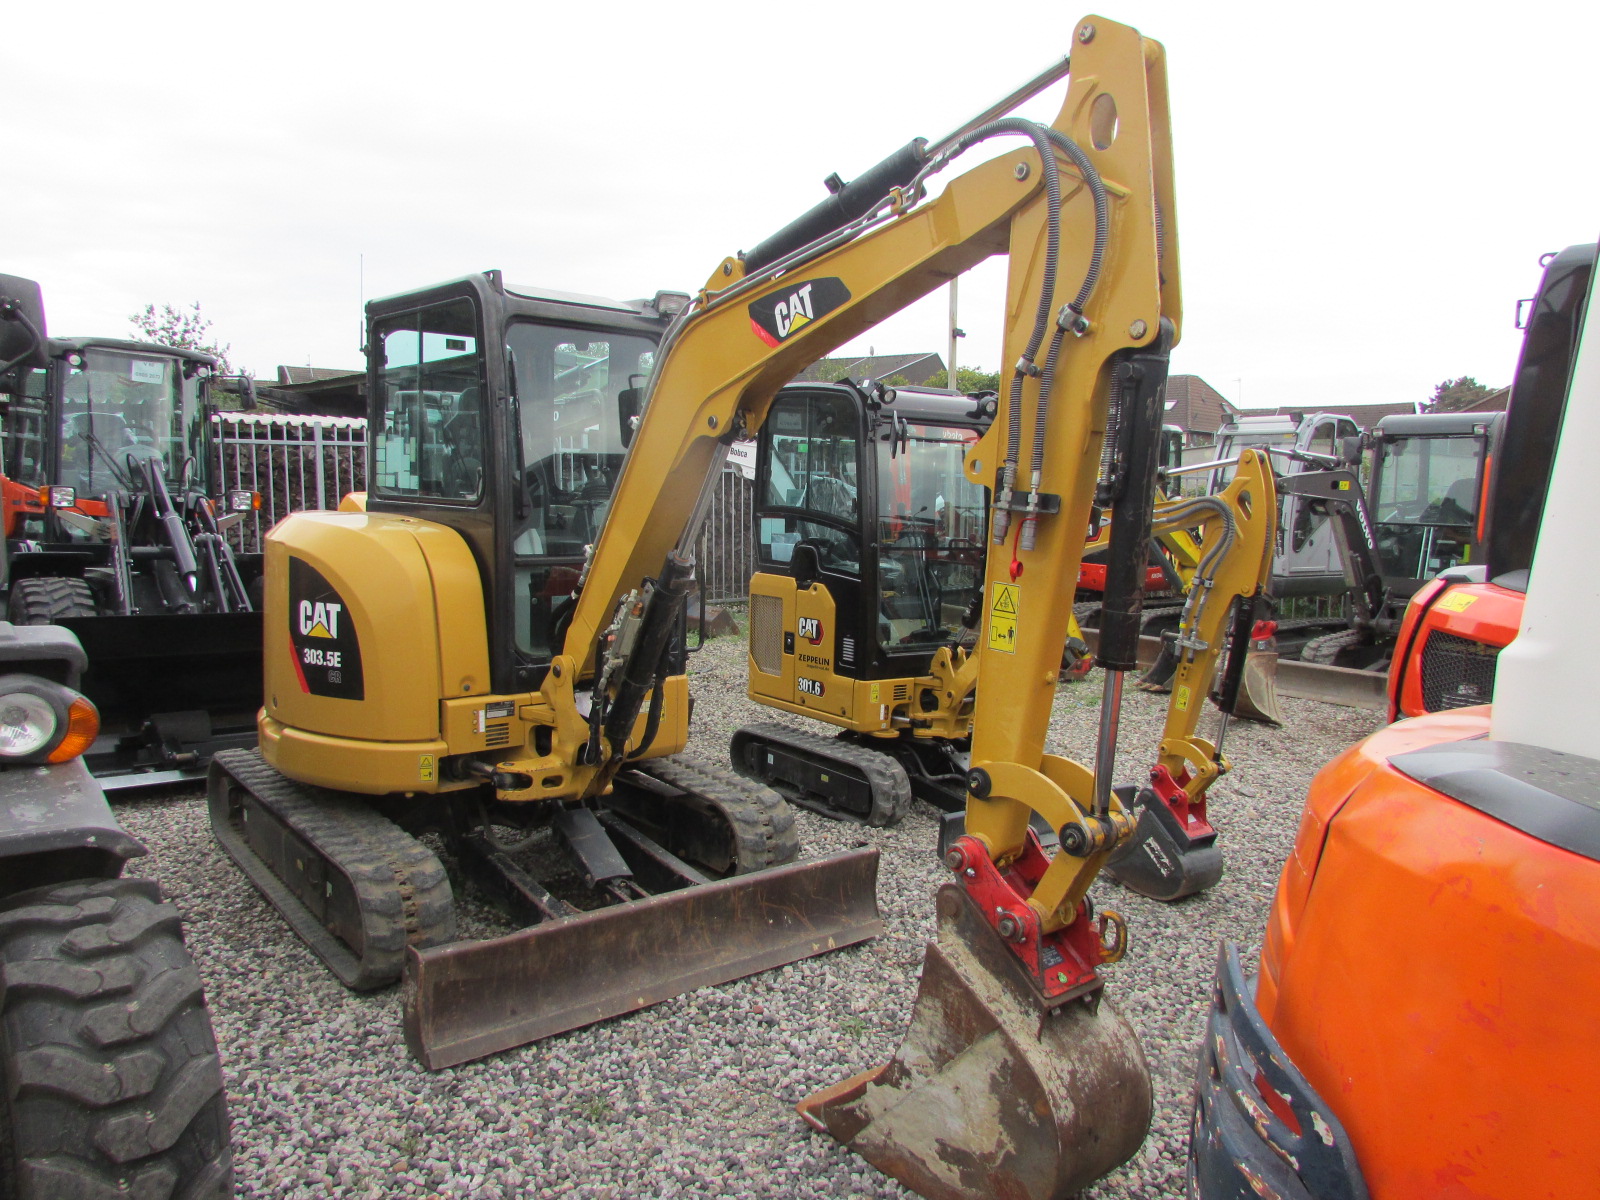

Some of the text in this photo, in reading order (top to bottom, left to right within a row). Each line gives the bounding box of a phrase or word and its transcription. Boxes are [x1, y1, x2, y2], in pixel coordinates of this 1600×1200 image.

[774, 283, 814, 338] CAT
[1356, 498, 1373, 550] VOLVO
[299, 600, 342, 639] CAT
[798, 617, 818, 639] CAT
[303, 647, 342, 668] 303.5E
[798, 653, 830, 666] ZEPPELIN
[328, 669, 342, 684] CR
[797, 677, 821, 696] 301.6
